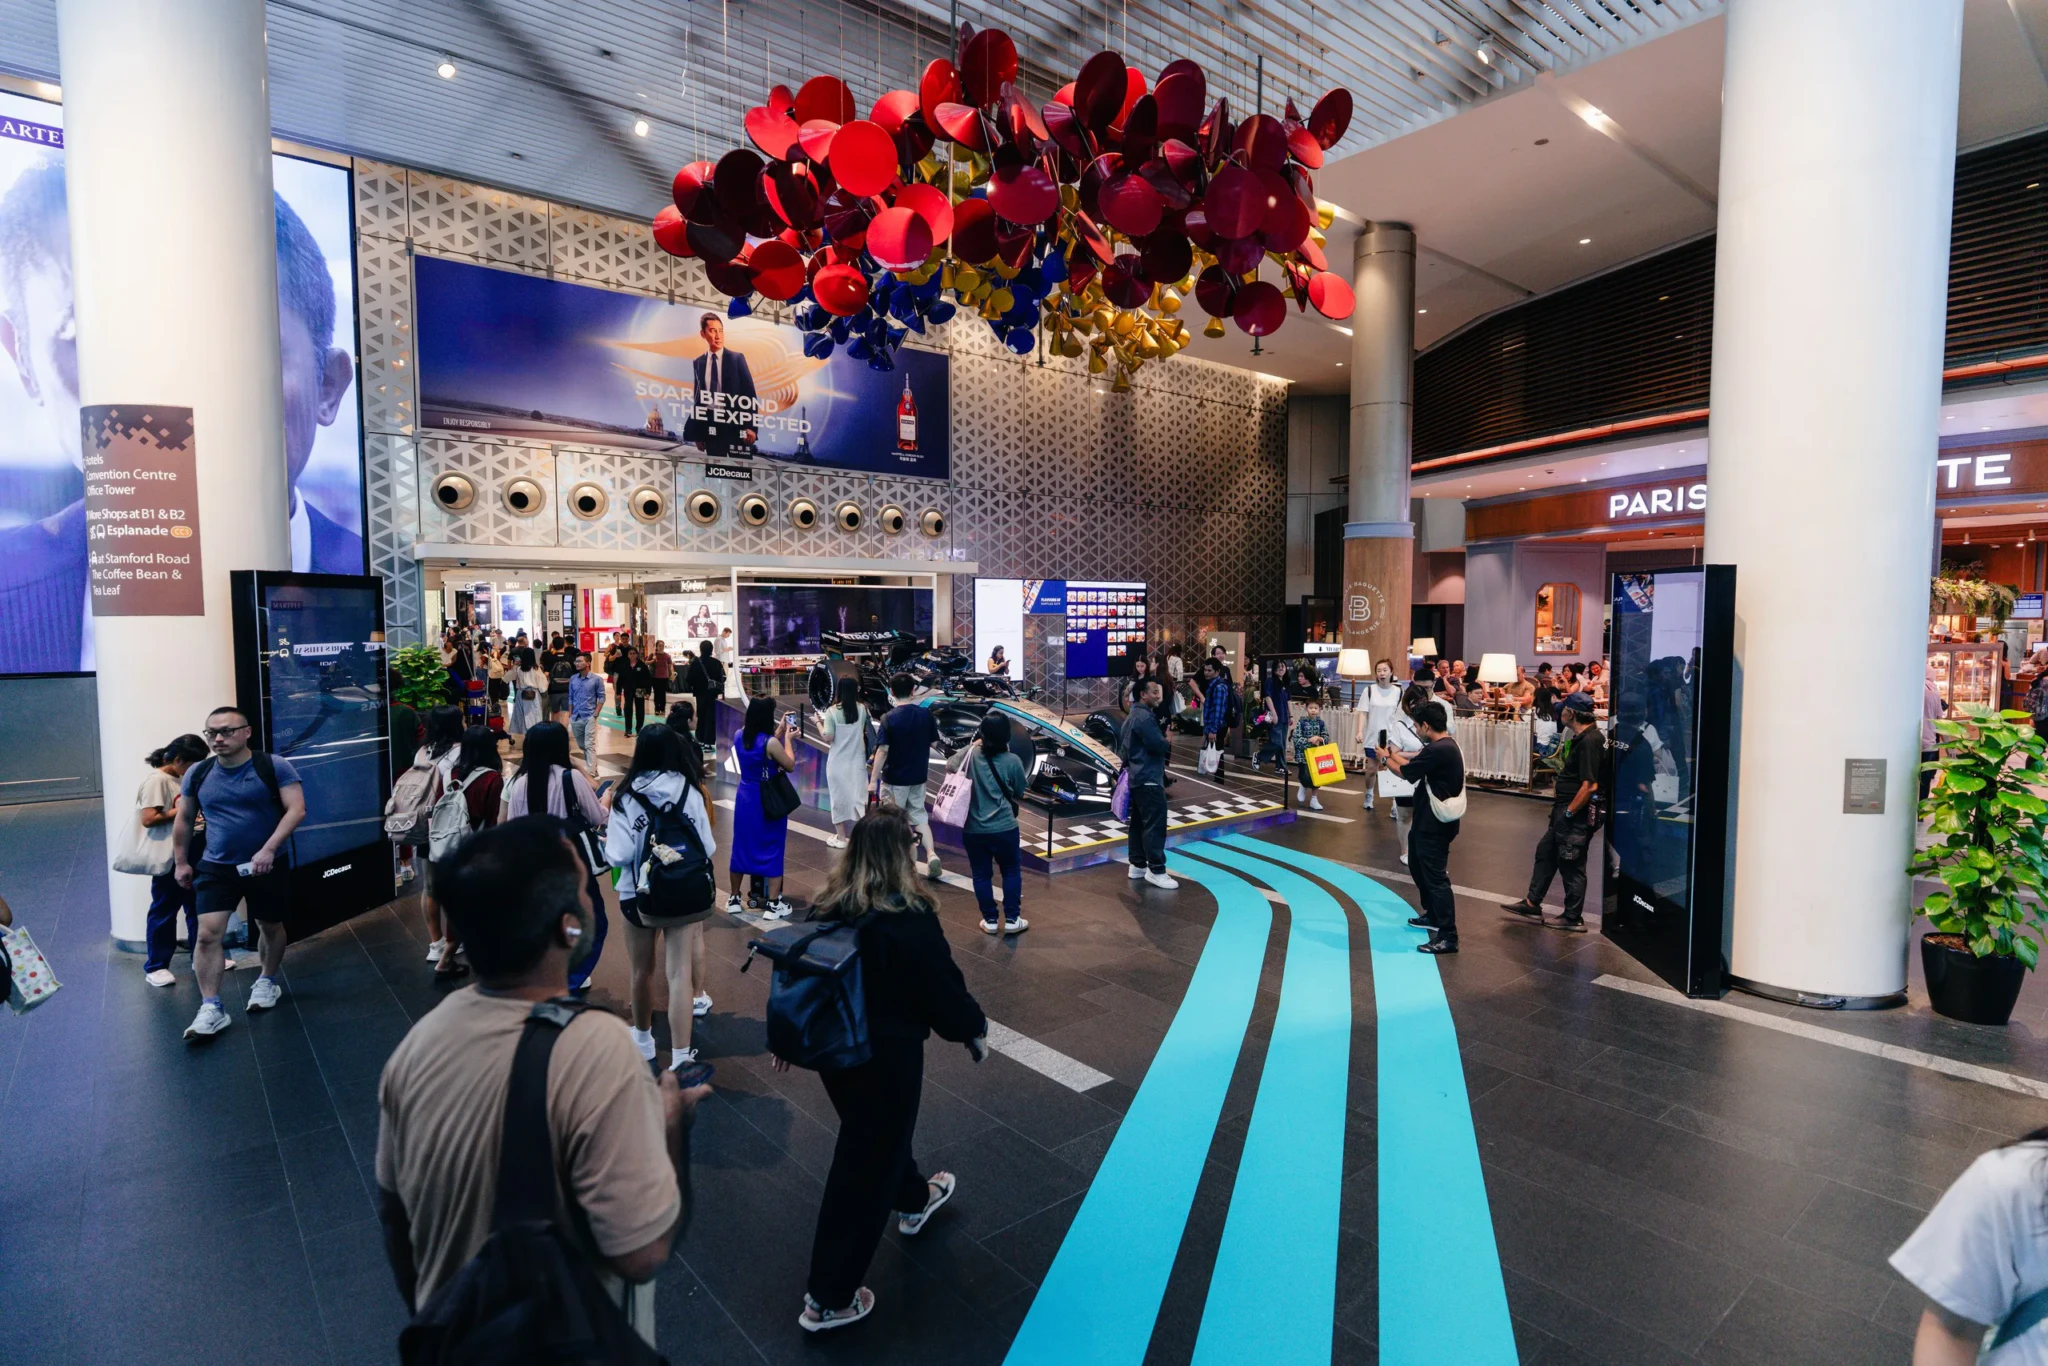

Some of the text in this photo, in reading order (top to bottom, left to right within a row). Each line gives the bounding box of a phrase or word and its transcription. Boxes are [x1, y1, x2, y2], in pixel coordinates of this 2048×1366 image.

[635, 381, 779, 413] SOAR BEYOND
[443, 417, 491, 428] ENJOY RESPONSIBLY
[668, 402, 811, 433] THE EXPECTED
[86, 469, 177, 481] Convention Centre
[707, 467, 750, 478] JCDecaux
[87, 484, 136, 496] Office Tower
[1609, 484, 1707, 518] PARIS
[89, 508, 186, 521] More Shops at B1 & B2
[107, 525, 168, 537] Esplanade
[97, 553, 190, 564] at Stamford Road
[92, 568, 182, 580] The Coffee Bean &
[93, 585, 120, 595] Tea Leaf
[1354, 581, 1385, 603] BAGUETTE
[1319, 759, 1334, 769] LEGO
[322, 863, 352, 878] JCDecaux
